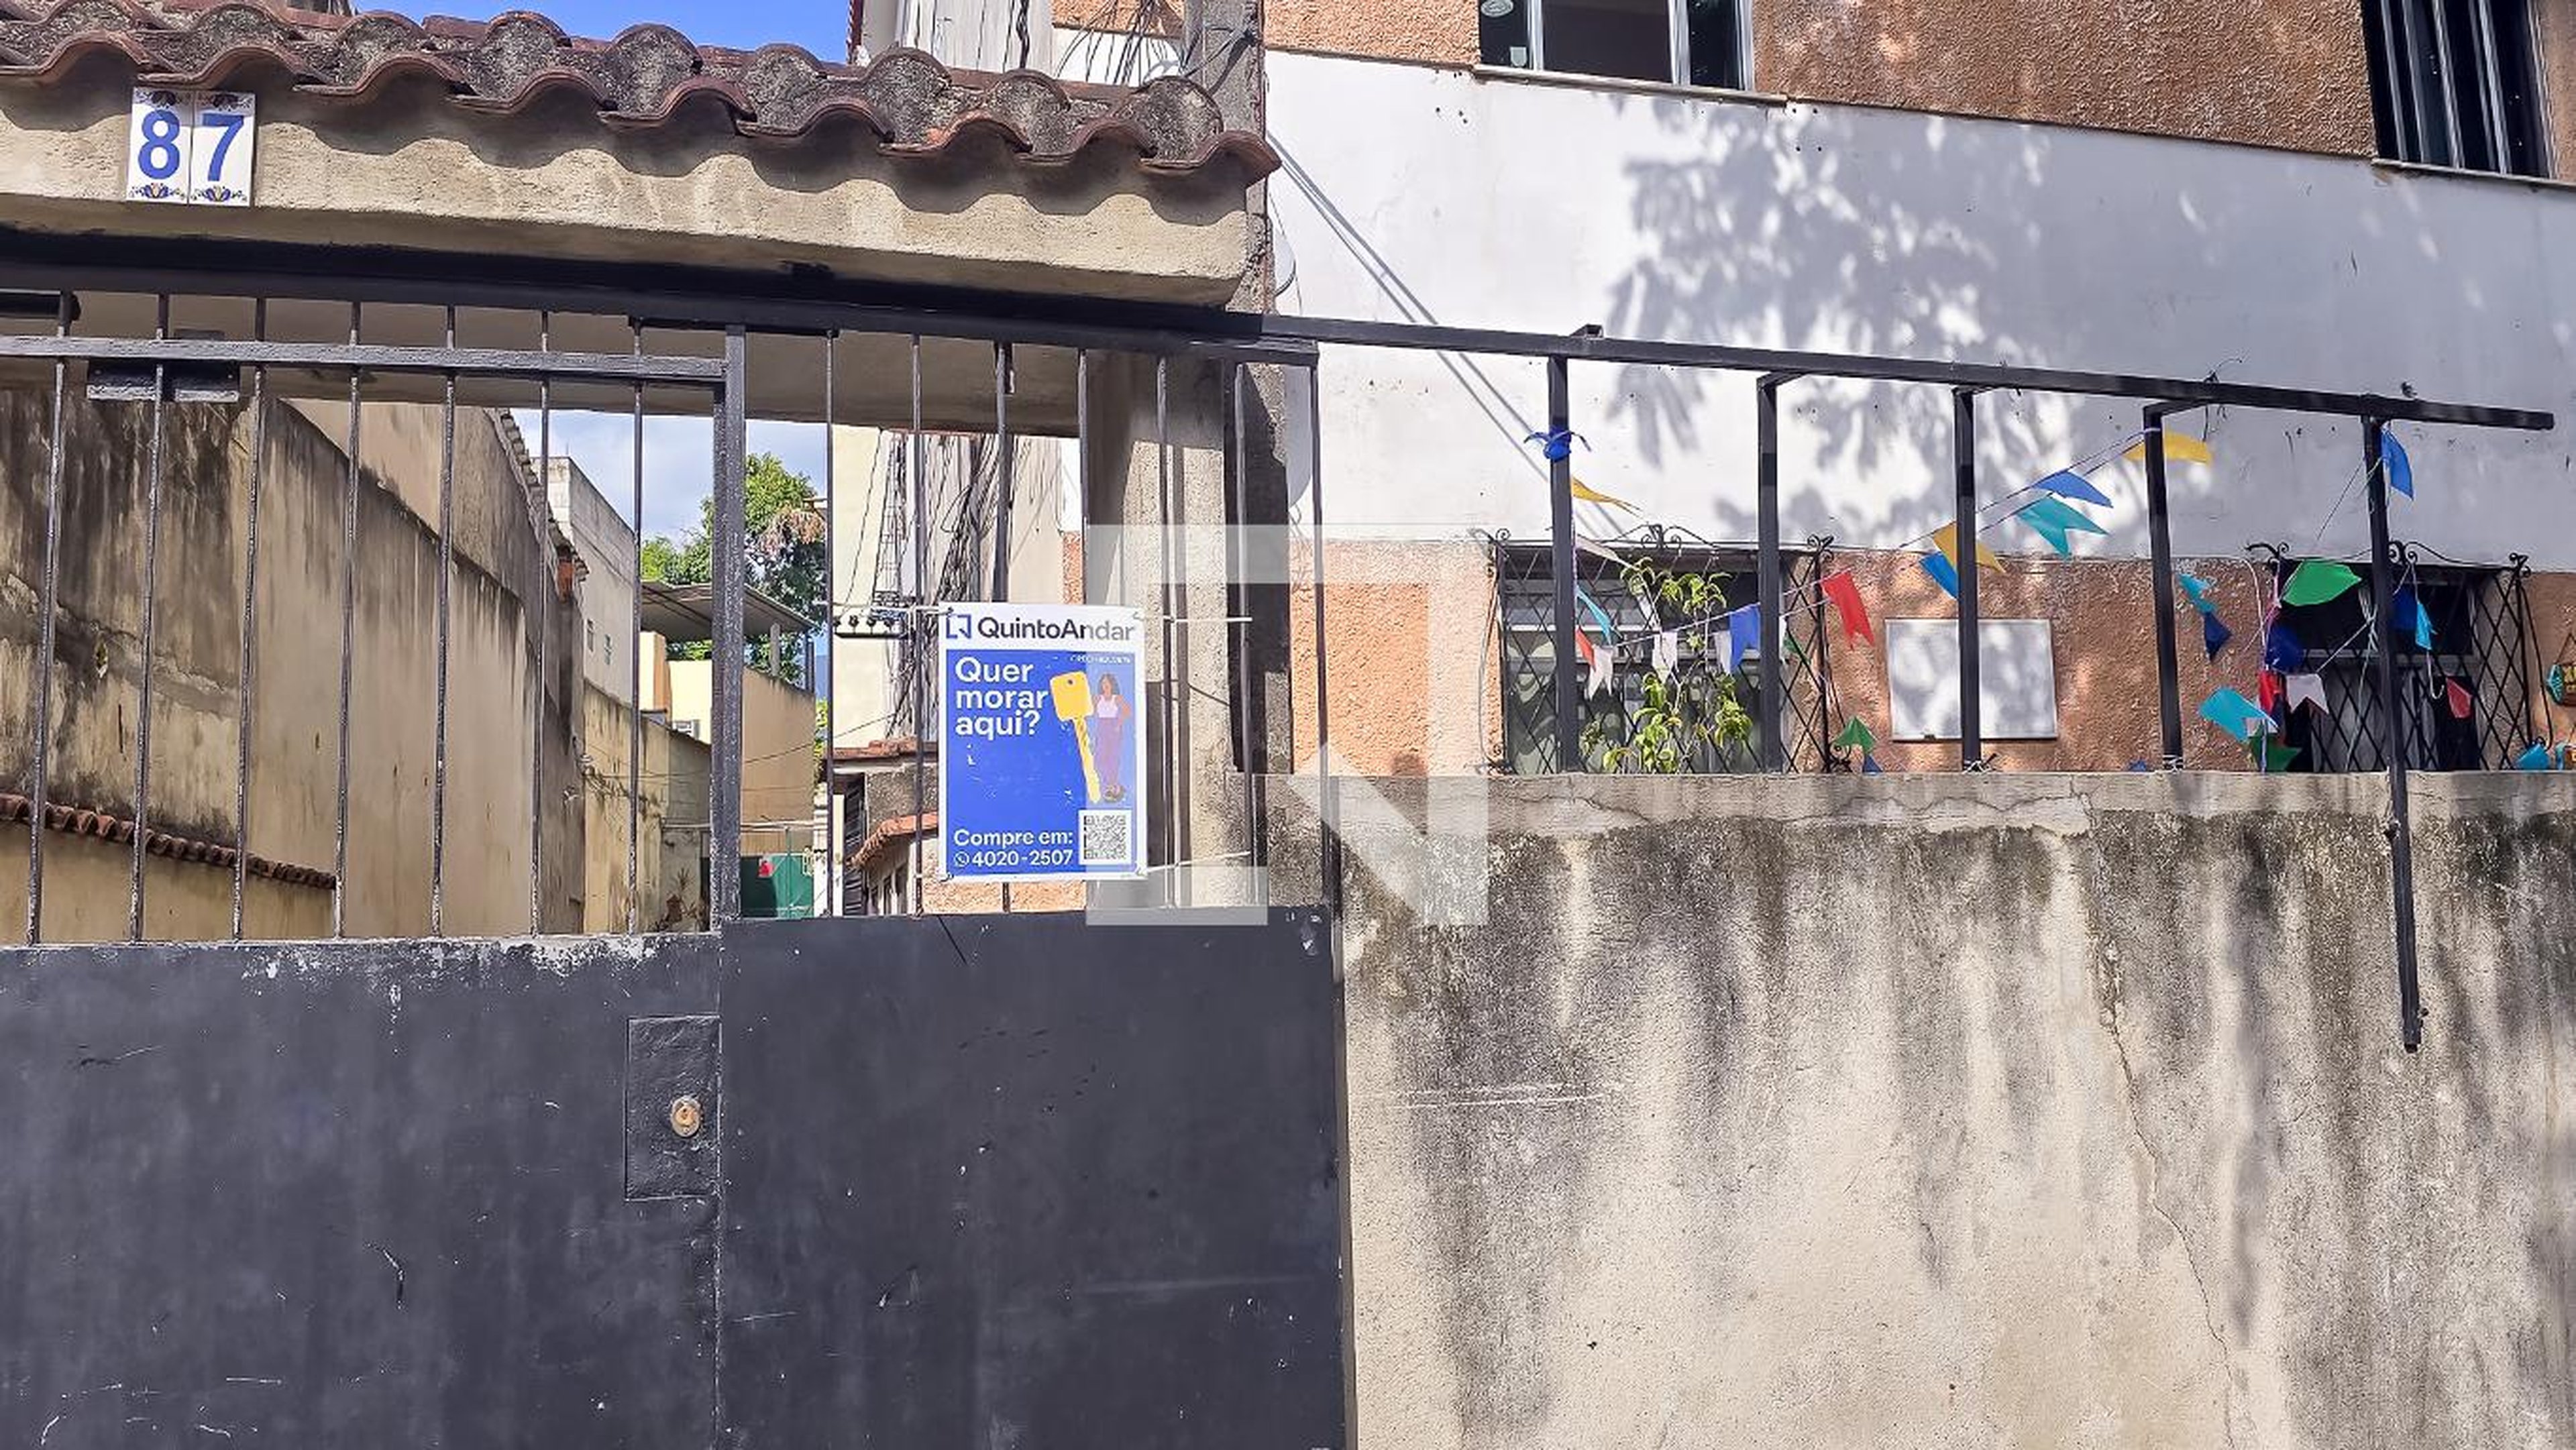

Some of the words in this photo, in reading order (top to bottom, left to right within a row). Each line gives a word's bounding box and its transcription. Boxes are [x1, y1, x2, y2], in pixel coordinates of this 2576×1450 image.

[138, 109, 244, 182] 87
[977, 616, 1134, 641] QuintoAndar
[955, 657, 1034, 683] Quer
[955, 688, 1049, 710] morar
[955, 710, 1040, 740] aqui?
[953, 829, 1034, 848] Compre
[1038, 832, 1073, 844] em:
